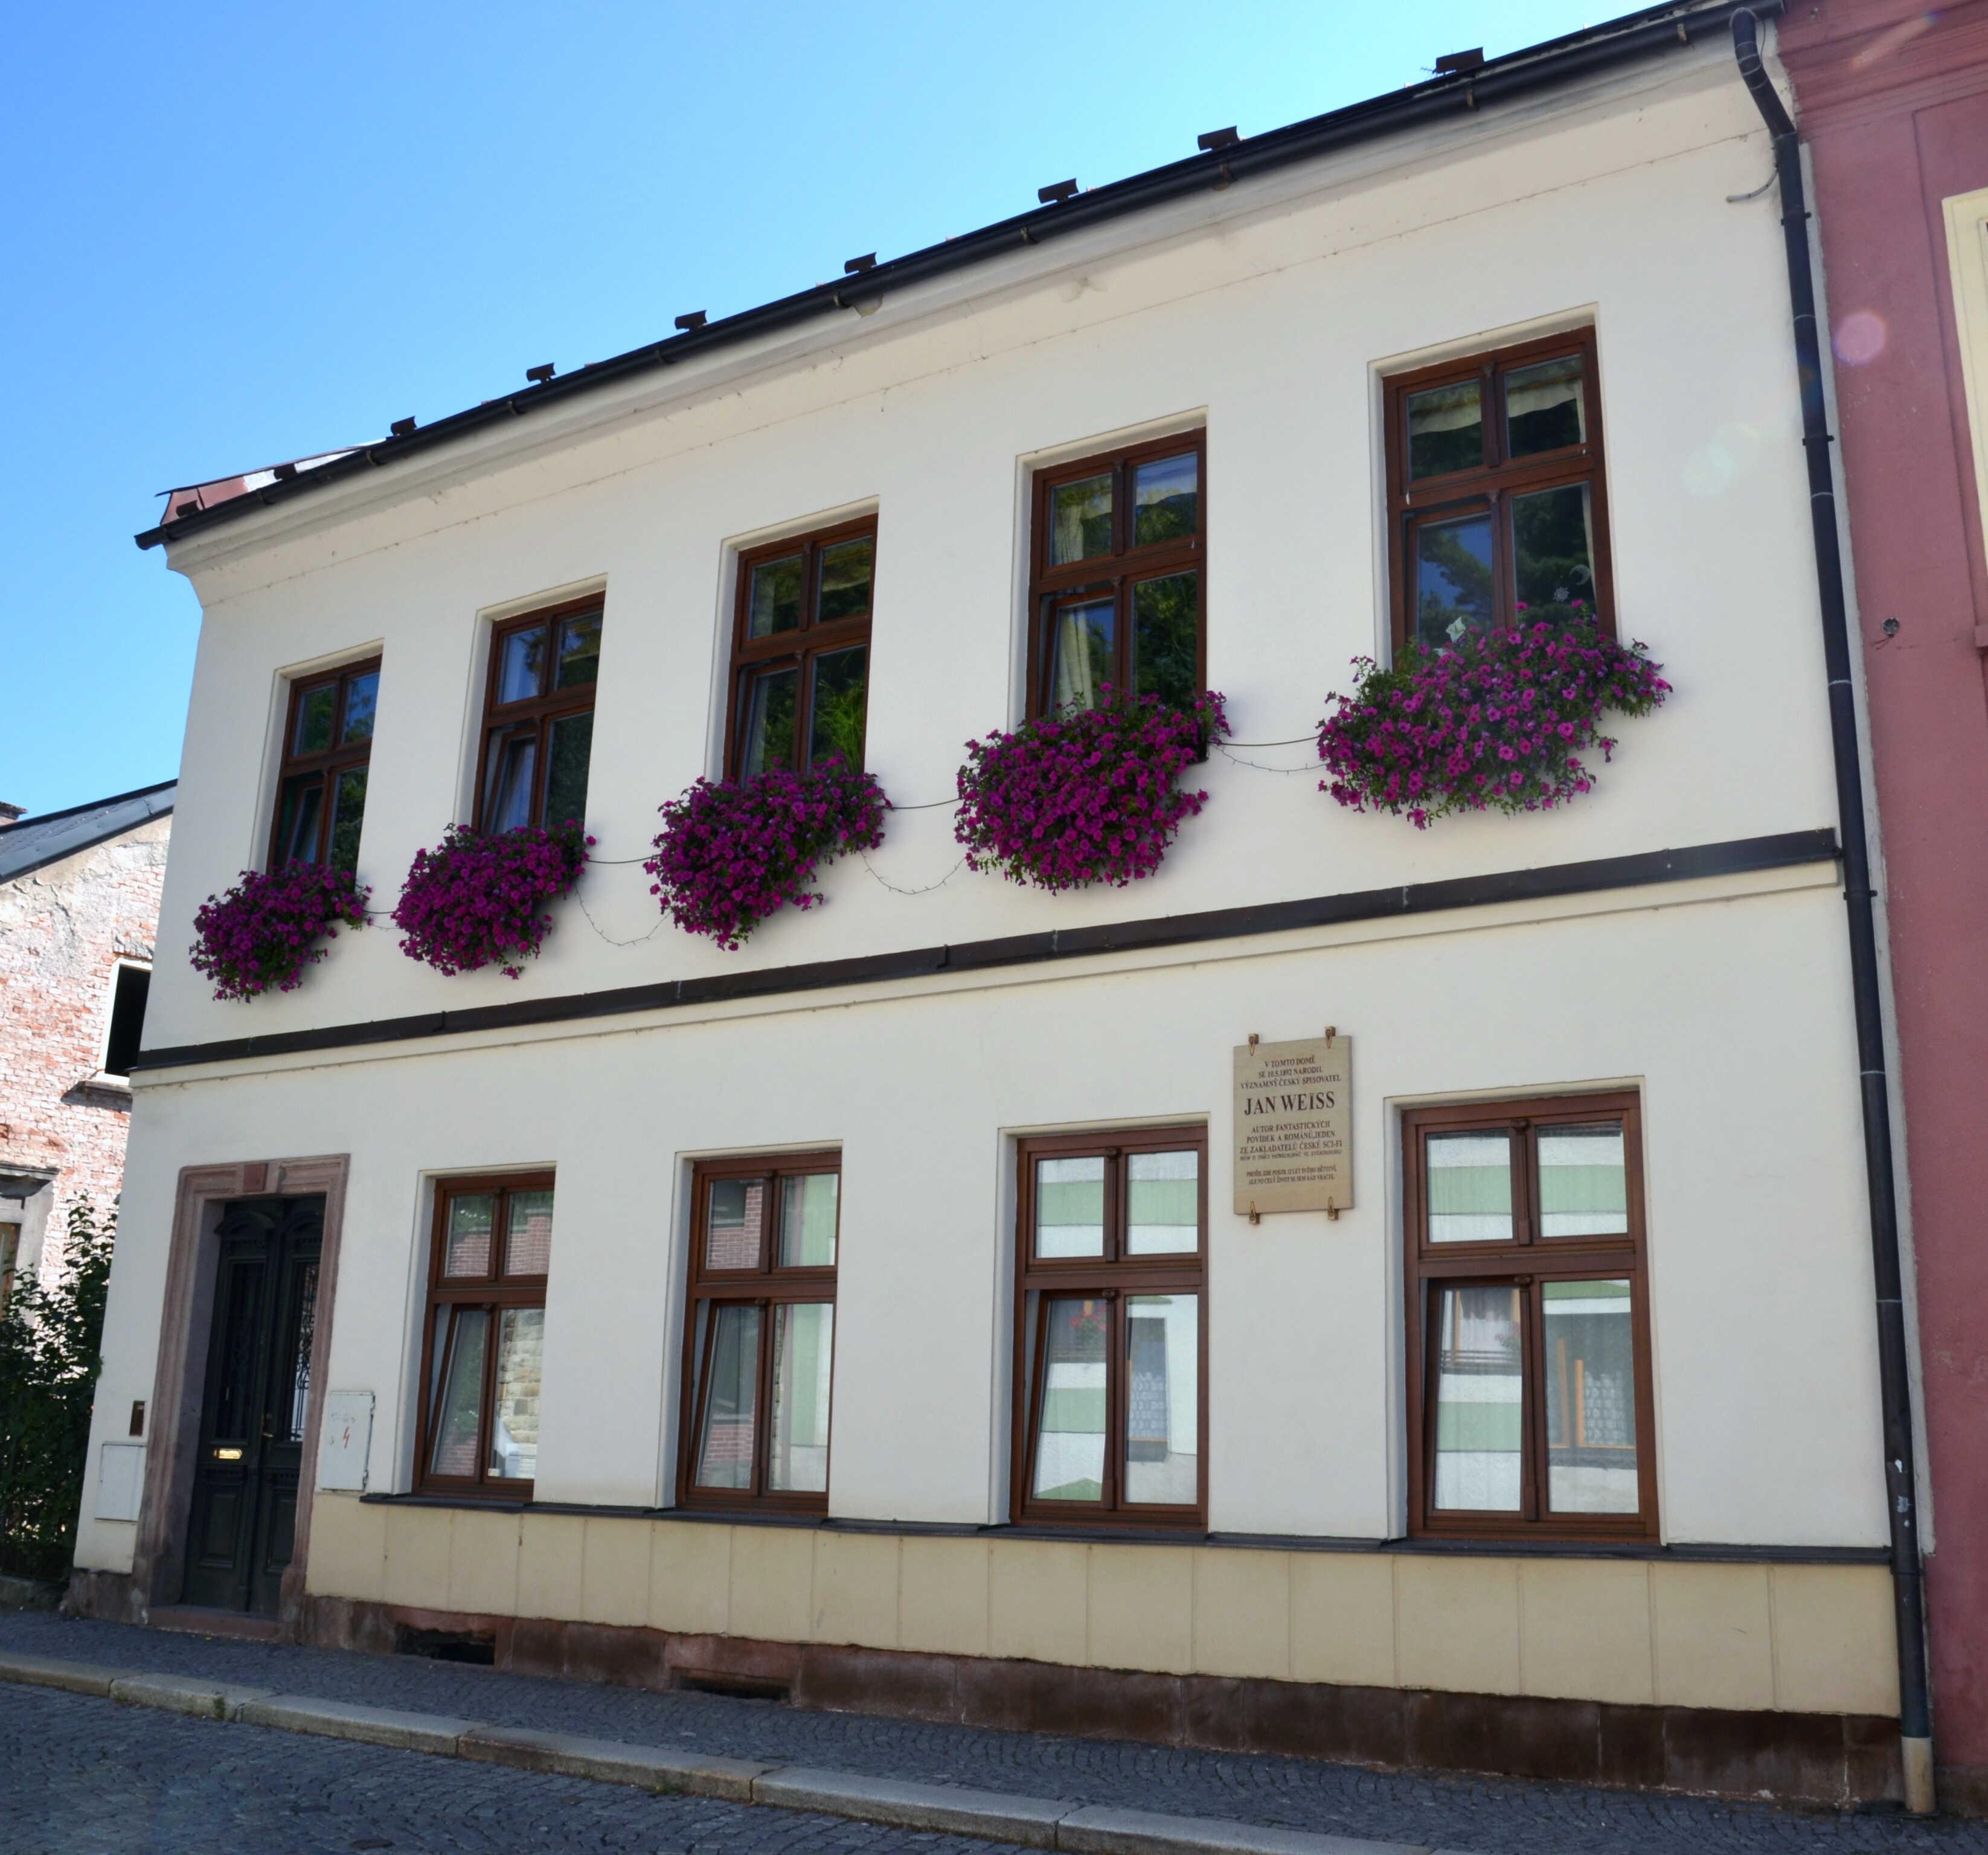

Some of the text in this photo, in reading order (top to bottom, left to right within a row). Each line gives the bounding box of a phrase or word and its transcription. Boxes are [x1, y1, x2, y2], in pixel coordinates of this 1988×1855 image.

[1271, 1059, 1295, 1067] TOMTO
[1268, 1069, 1292, 1077] 10.5.1892
[1240, 1074, 1341, 1089] VÝZNAMNÝ ČESKÝ SPISOVATEL
[1245, 1091, 1335, 1115] JAN WEISS
[1276, 1120, 1330, 1132] FANTASTICKÝCH
[1246, 1134, 1275, 1143] POVÍDEK
[1250, 1142, 1297, 1153] ZAKLADATELŮ
[1300, 1141, 1320, 1150] ČESKÉ
